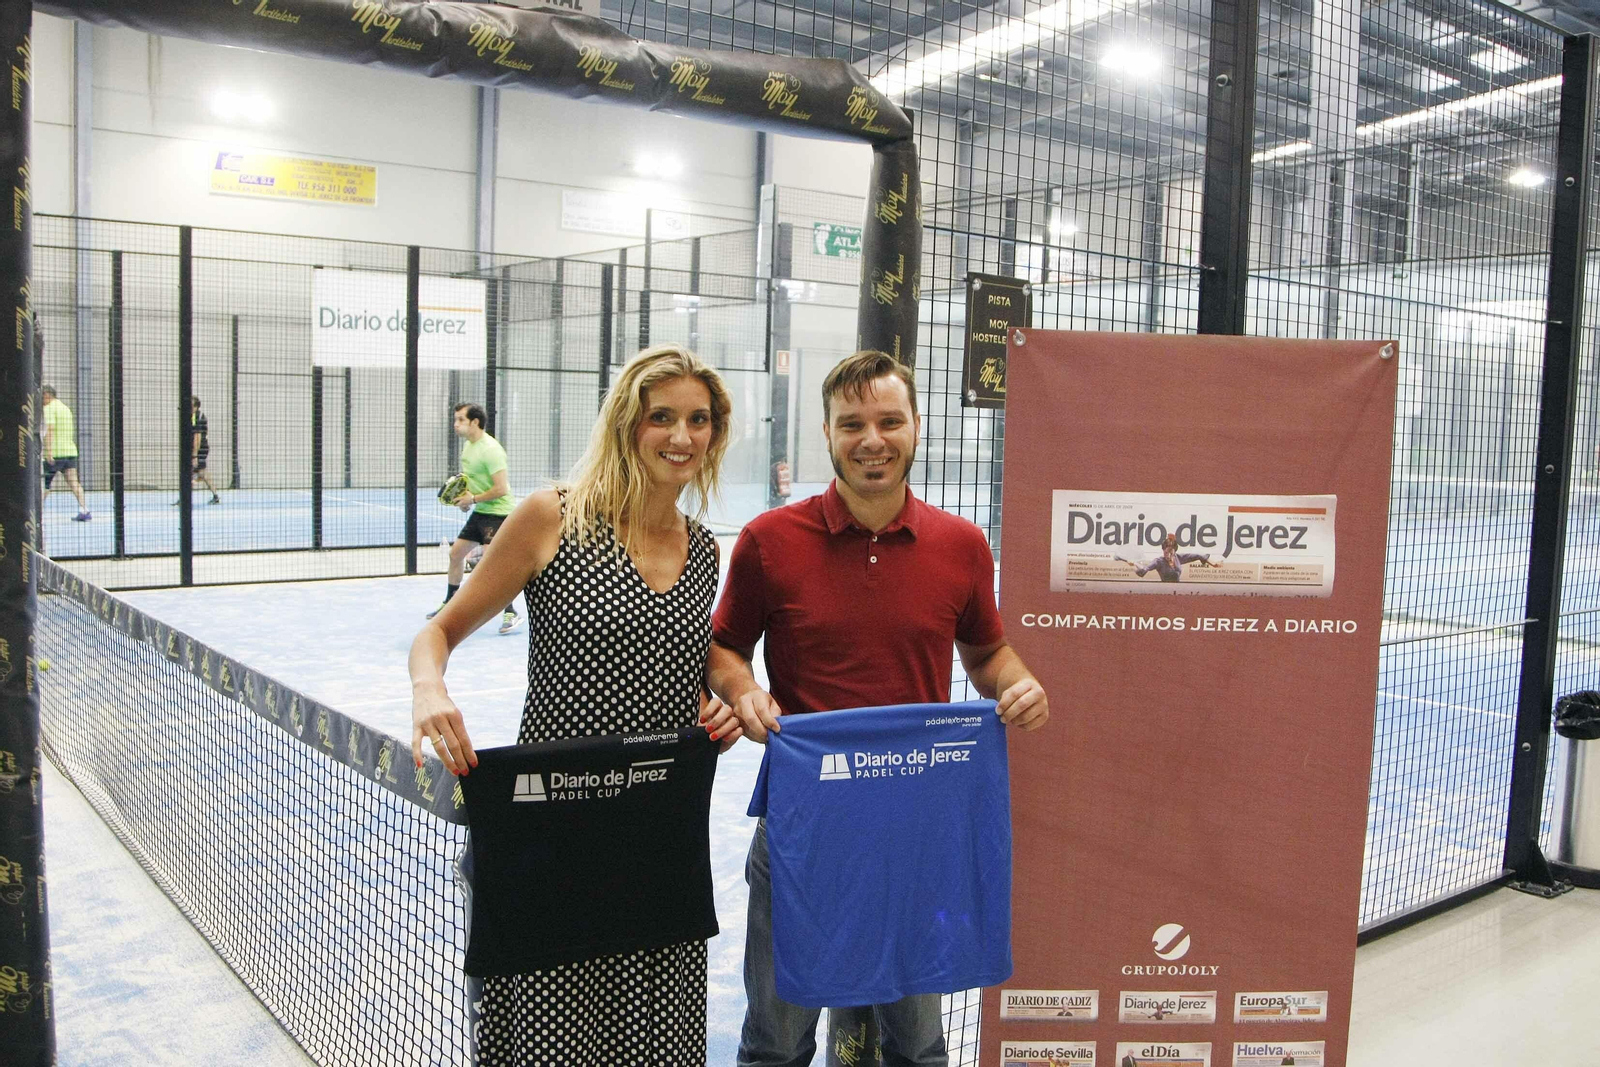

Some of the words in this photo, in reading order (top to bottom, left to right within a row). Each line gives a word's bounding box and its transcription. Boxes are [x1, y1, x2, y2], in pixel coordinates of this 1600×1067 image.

[467, 22, 516, 63] Moy
[576, 44, 618, 85] Moy
[669, 61, 711, 98] Moy
[761, 78, 799, 116] Moy
[844, 94, 878, 130] Moy
[312, 183, 325, 192] 956
[343, 185, 357, 195] 000
[880, 189, 907, 225] Moy
[876, 270, 902, 306] Moy
[988, 294, 1011, 307] PISTA
[320, 307, 382, 331] Diario
[386, 309, 408, 332] de
[417, 312, 466, 339] Jerez
[989, 319, 1009, 330] MOY
[979, 364, 1003, 391] Moy
[1067, 511, 1167, 547] Diario
[1175, 514, 1218, 547] de
[1222, 515, 1308, 558] Jerez
[1021, 613, 1186, 631] COMPARTIMOS
[1190, 617, 1259, 632] JEREZ
[1264, 618, 1279, 632] A
[1284, 619, 1358, 634] DIARIO
[854, 751, 903, 767] Diario
[906, 748, 927, 765] de
[930, 748, 970, 767] Jerez
[550, 772, 600, 789] Diario
[603, 769, 625, 786] de
[626, 767, 668, 789] Jerez
[856, 768, 894, 779] PADEL
[900, 766, 924, 776] CUP
[551, 790, 590, 801] PADEL
[597, 788, 621, 798] CUP
[1121, 964, 1220, 976] GRUPOJOLY
[1007, 995, 1044, 1006] DIARIO
[1045, 995, 1060, 1006] DE
[1124, 997, 1159, 1009] Diario
[1161, 998, 1176, 1009] de
[1177, 998, 1207, 1012] Jerez
[840, 1034, 861, 1067] Moy
[1004, 1047, 1039, 1058] Diario
[1040, 1047, 1055, 1059] de
[1056, 1047, 1094, 1059] Sevilla
[1236, 1044, 1283, 1056] Huelva
